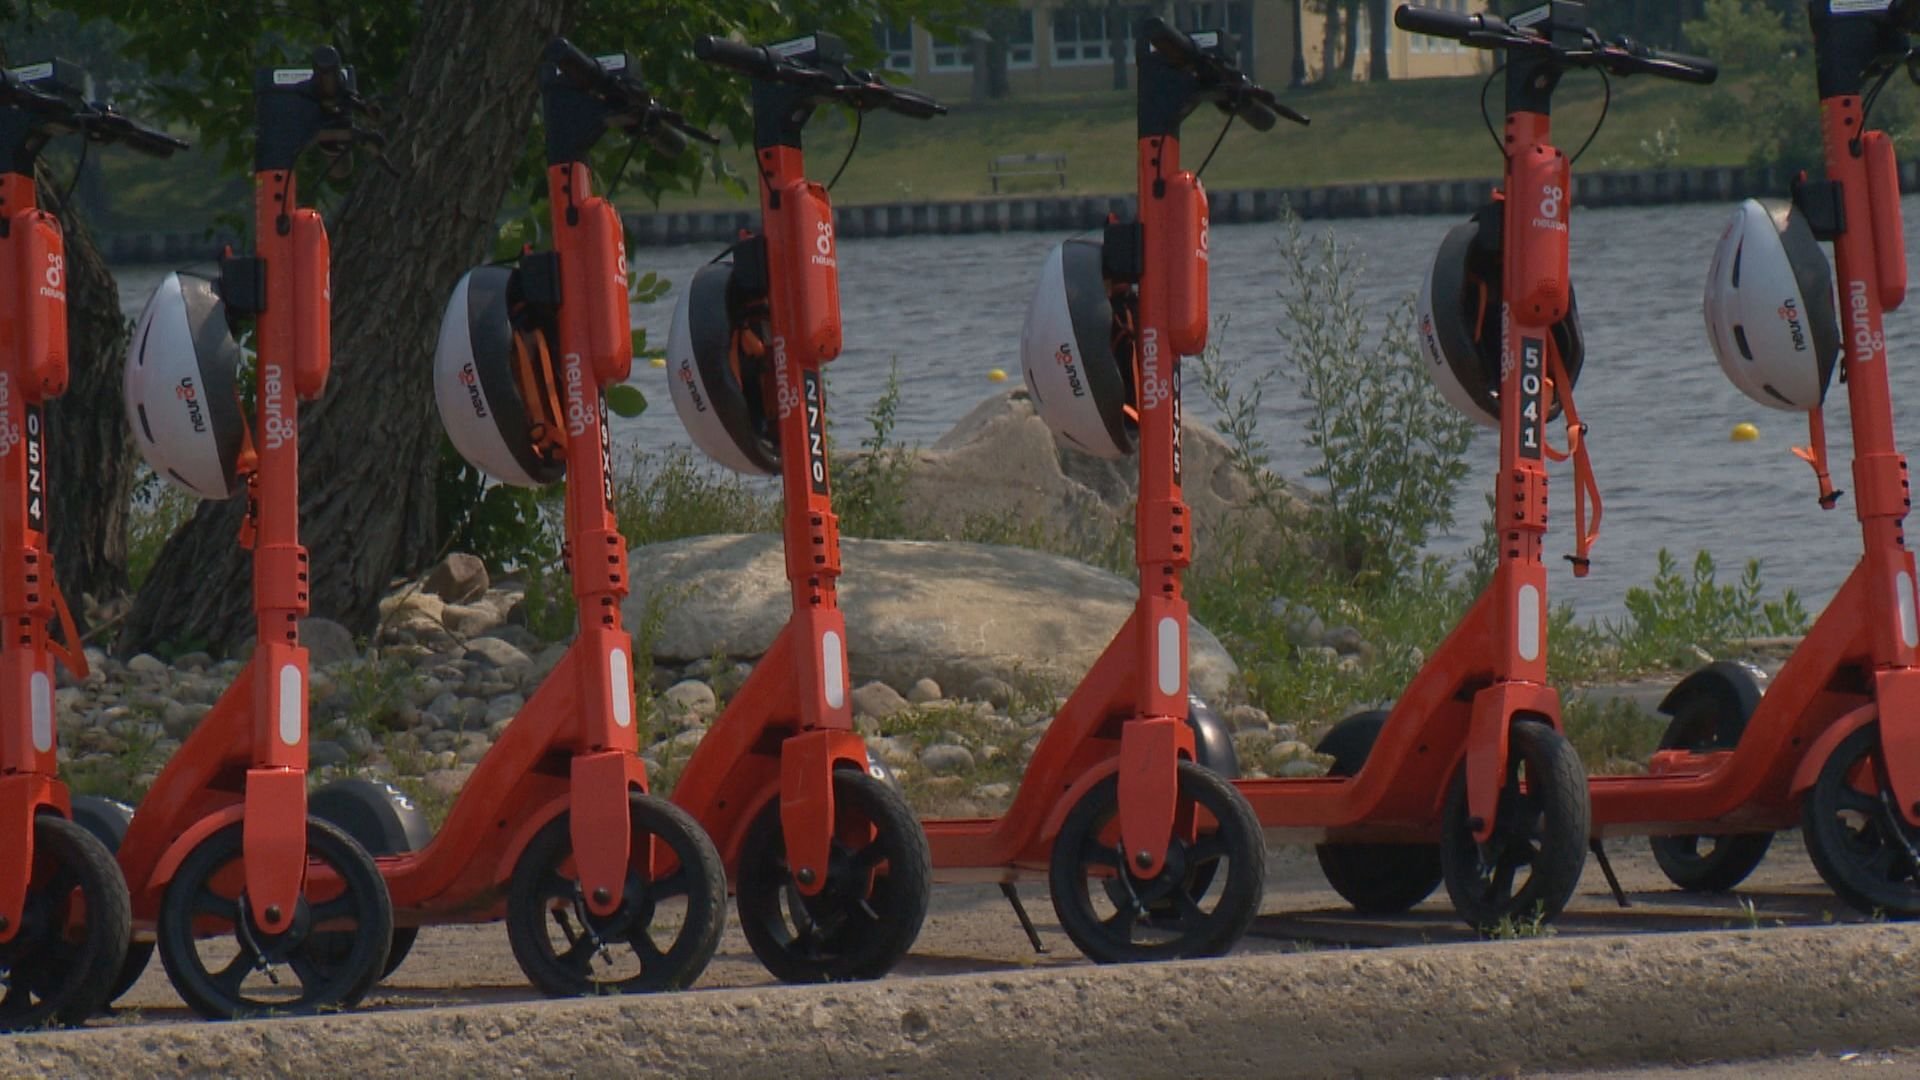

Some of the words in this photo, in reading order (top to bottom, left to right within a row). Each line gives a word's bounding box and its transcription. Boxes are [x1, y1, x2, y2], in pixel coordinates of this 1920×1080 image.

[1778, 298, 1807, 352] neuron
[1849, 280, 1883, 362] neuron
[176, 377, 206, 433] neuron
[265, 364, 294, 449] neuron
[457, 362, 487, 418] neuron
[565, 352, 595, 437] neuron
[774, 336, 799, 419] neuron
[1055, 343, 1085, 397] neuron
[1143, 328, 1169, 410] neuron
[1522, 346, 1540, 449] 5041
